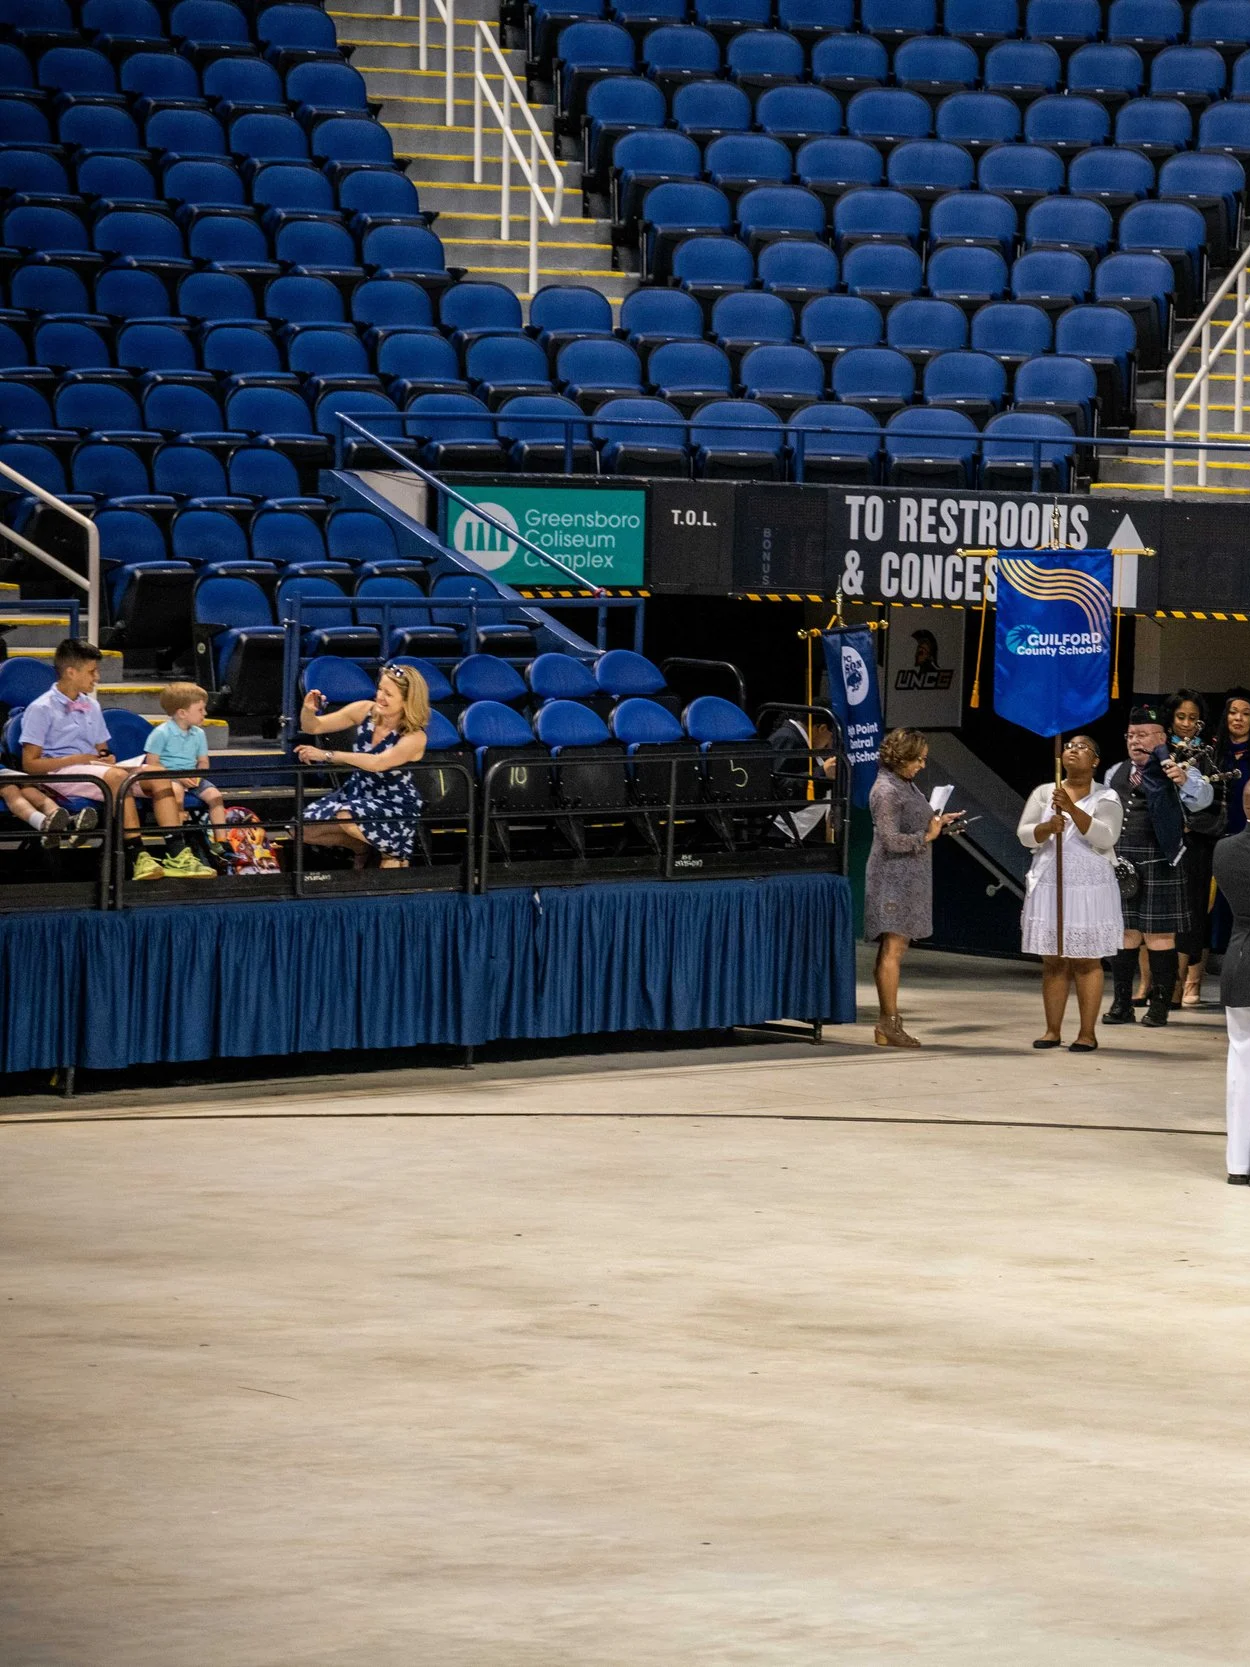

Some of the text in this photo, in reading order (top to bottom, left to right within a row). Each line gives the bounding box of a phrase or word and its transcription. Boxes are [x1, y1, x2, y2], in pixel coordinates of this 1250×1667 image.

[525, 508, 640, 528] Greensboro
[671, 509, 717, 527] T.O.L.
[845, 495, 1089, 550] TO RESTROOMS
[524, 529, 616, 548] Coliseum
[762, 527, 772, 586] BONUS
[842, 548, 864, 596] &
[1027, 632, 1101, 646] GUILFORD
[1017, 644, 1102, 657] County Schools
[895, 669, 953, 690] UNCG
[855, 722, 879, 735] Point
[855, 750, 881, 763] Schoo
